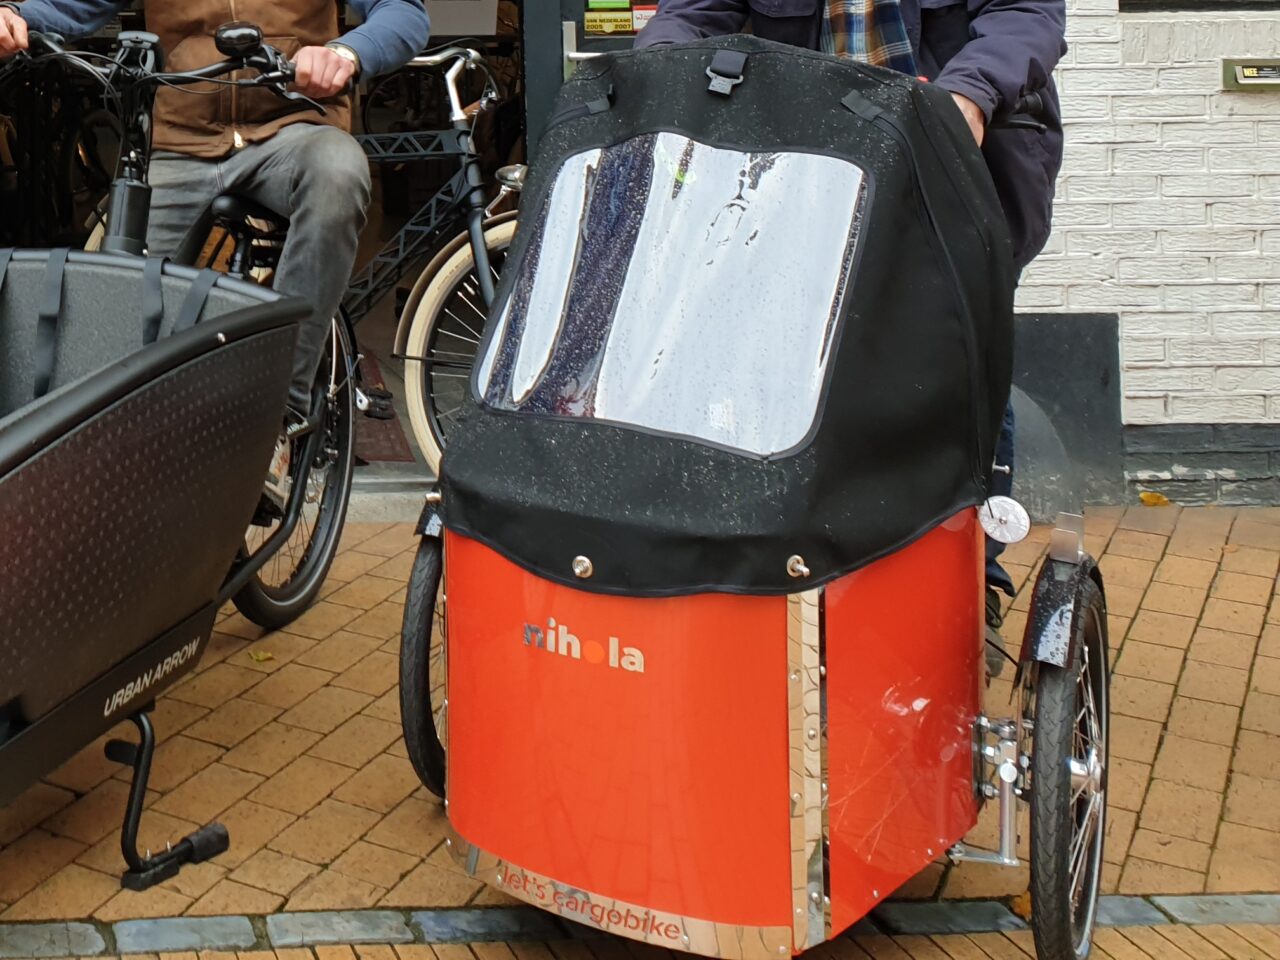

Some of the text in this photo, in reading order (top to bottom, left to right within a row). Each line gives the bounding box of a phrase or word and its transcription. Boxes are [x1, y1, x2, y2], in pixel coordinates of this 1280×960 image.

[103, 636, 200, 717] URBAN ARROW
[553, 892, 681, 941] cargobike
